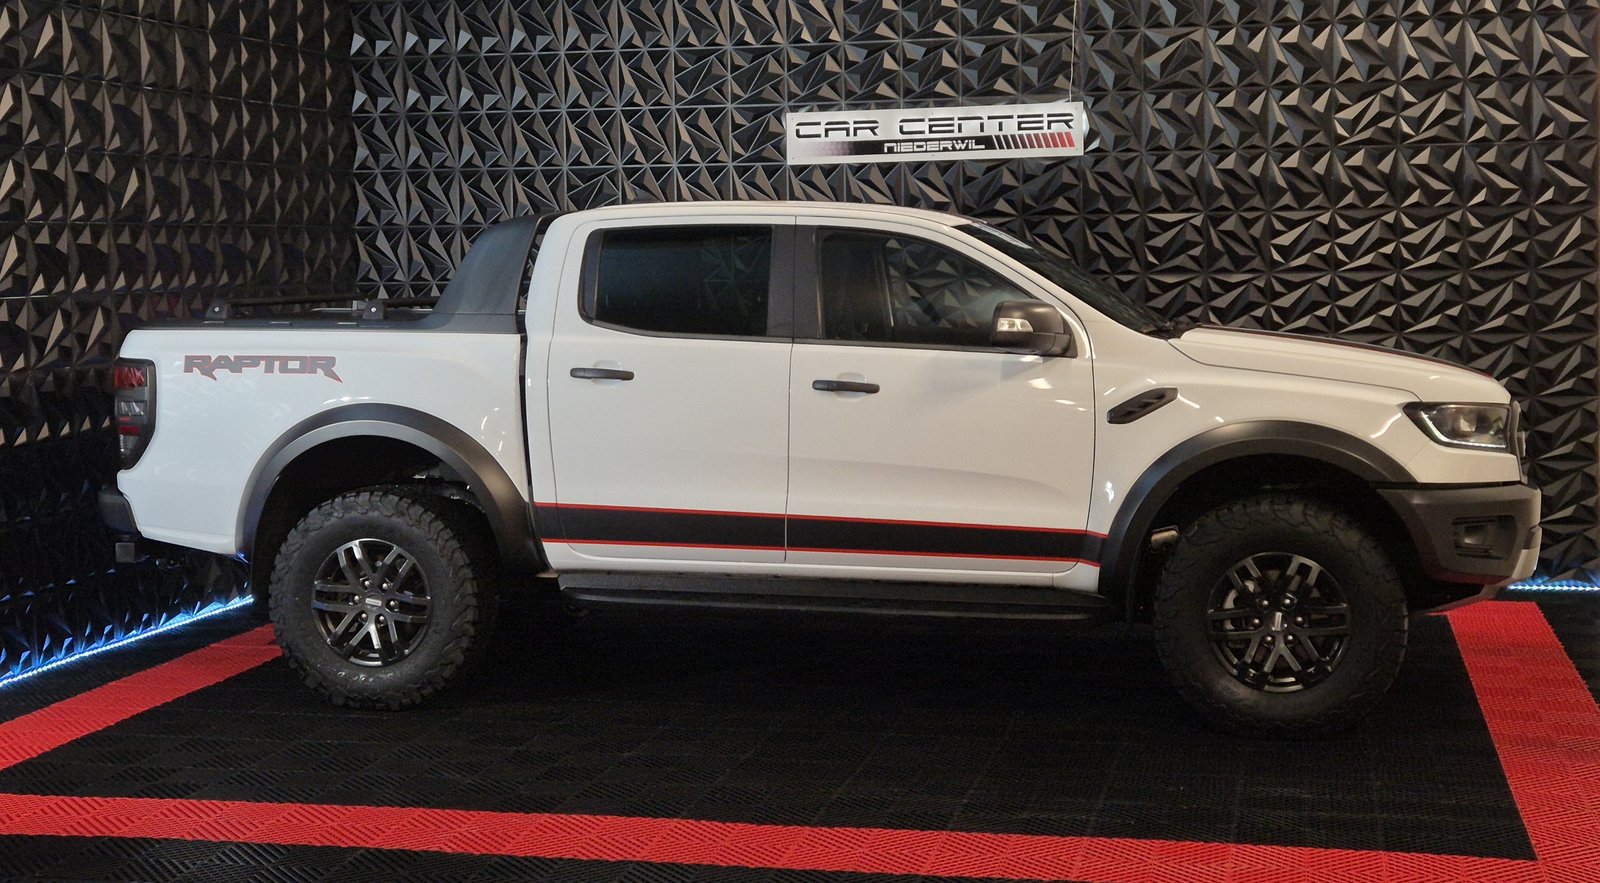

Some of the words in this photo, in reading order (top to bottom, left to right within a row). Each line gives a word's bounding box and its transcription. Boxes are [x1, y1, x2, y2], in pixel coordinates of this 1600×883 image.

[795, 120, 880, 139] CAR
[898, 112, 1074, 135] CENTER
[883, 140, 985, 153] NIEDERWIL
[183, 355, 343, 384] RAPTOR
